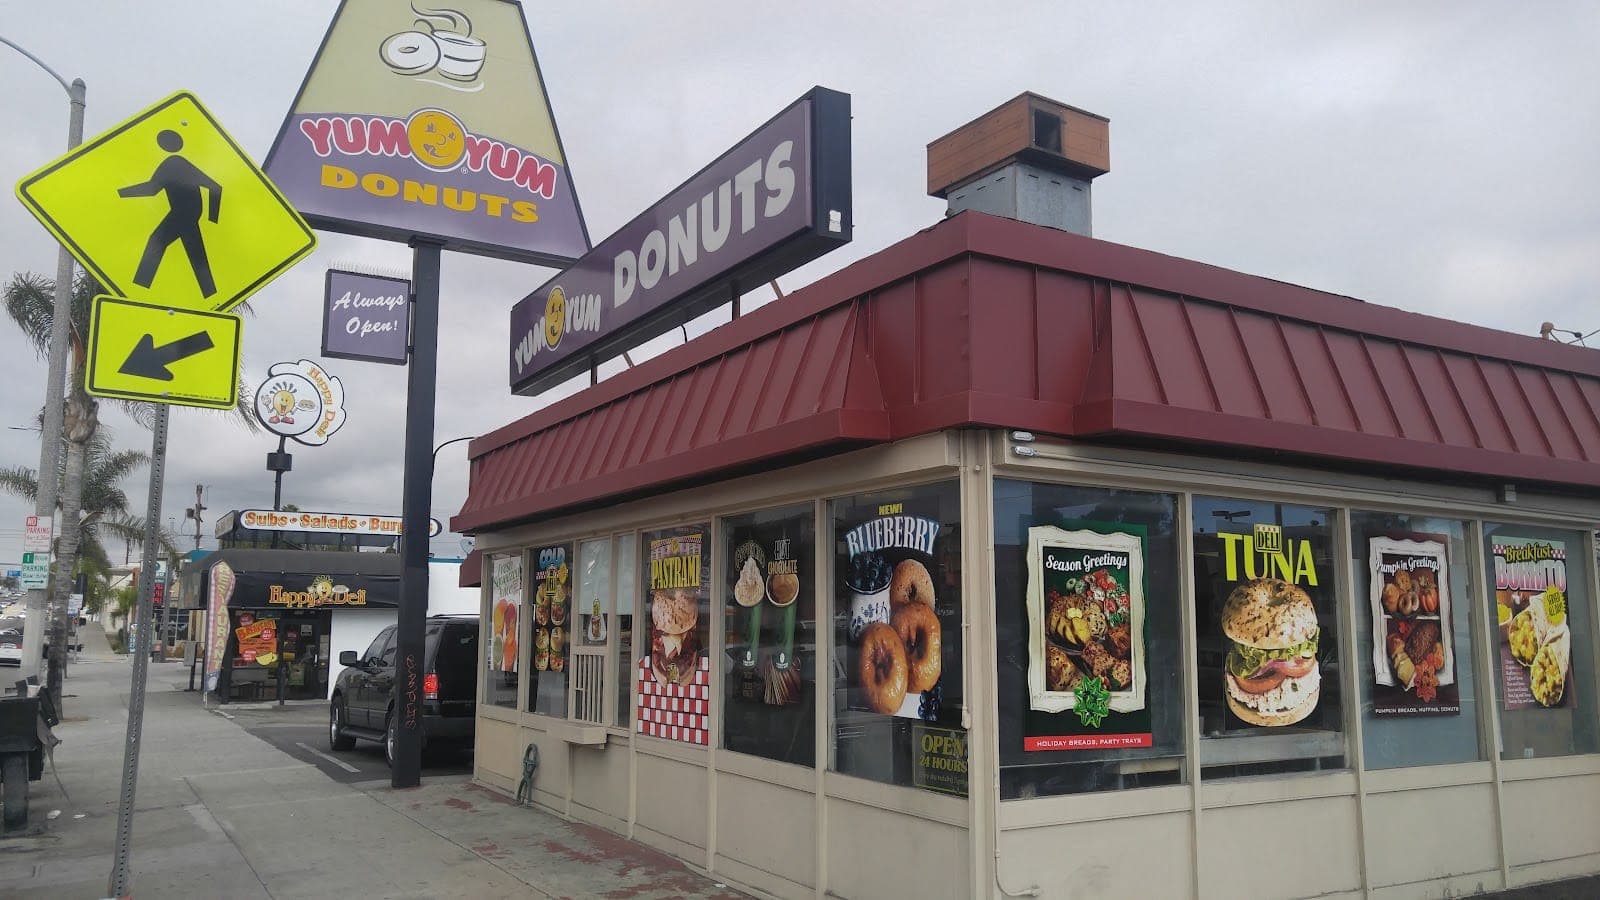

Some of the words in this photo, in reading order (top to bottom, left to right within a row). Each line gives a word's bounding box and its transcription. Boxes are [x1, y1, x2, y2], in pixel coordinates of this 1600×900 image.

[300, 116, 411, 157] YUM
[466, 135, 557, 199] YUM
[320, 164, 539, 223] DONUTS
[515, 316, 546, 374] YUM
[564, 294, 602, 334] YUM
[613, 140, 796, 309] DONUTS
[332, 291, 406, 312] Always
[346, 316, 398, 338] Open!
[878, 503, 903, 515] NEW!
[27, 517, 37, 527] NO
[245, 511, 288, 526] Subs
[300, 514, 359, 530] Salads
[846, 516, 939, 558] BLUEBERRY
[1256, 531, 1279, 549] DELI
[539, 547, 566, 570] COLD
[774, 539, 790, 560] HOT
[1217, 532, 1318, 587] TUNA
[1506, 542, 1551, 563] Breakfast
[651, 554, 701, 590] PASTRAMI
[767, 559, 798, 574] CHOCOLATE
[1046, 554, 1082, 571] Season
[1083, 552, 1127, 572] Greetings
[1375, 559, 1408, 576] Pumpkin
[1408, 556, 1440, 572] Greetings
[1494, 555, 1567, 592] BURRITO
[268, 585, 315, 608] Happy
[334, 588, 366, 605] Deli
[921, 734, 964, 757] OPEN
[1037, 739, 1067, 747] HOLIDAY
[919, 754, 930, 768] 24
[932, 756, 968, 773] HOURS
